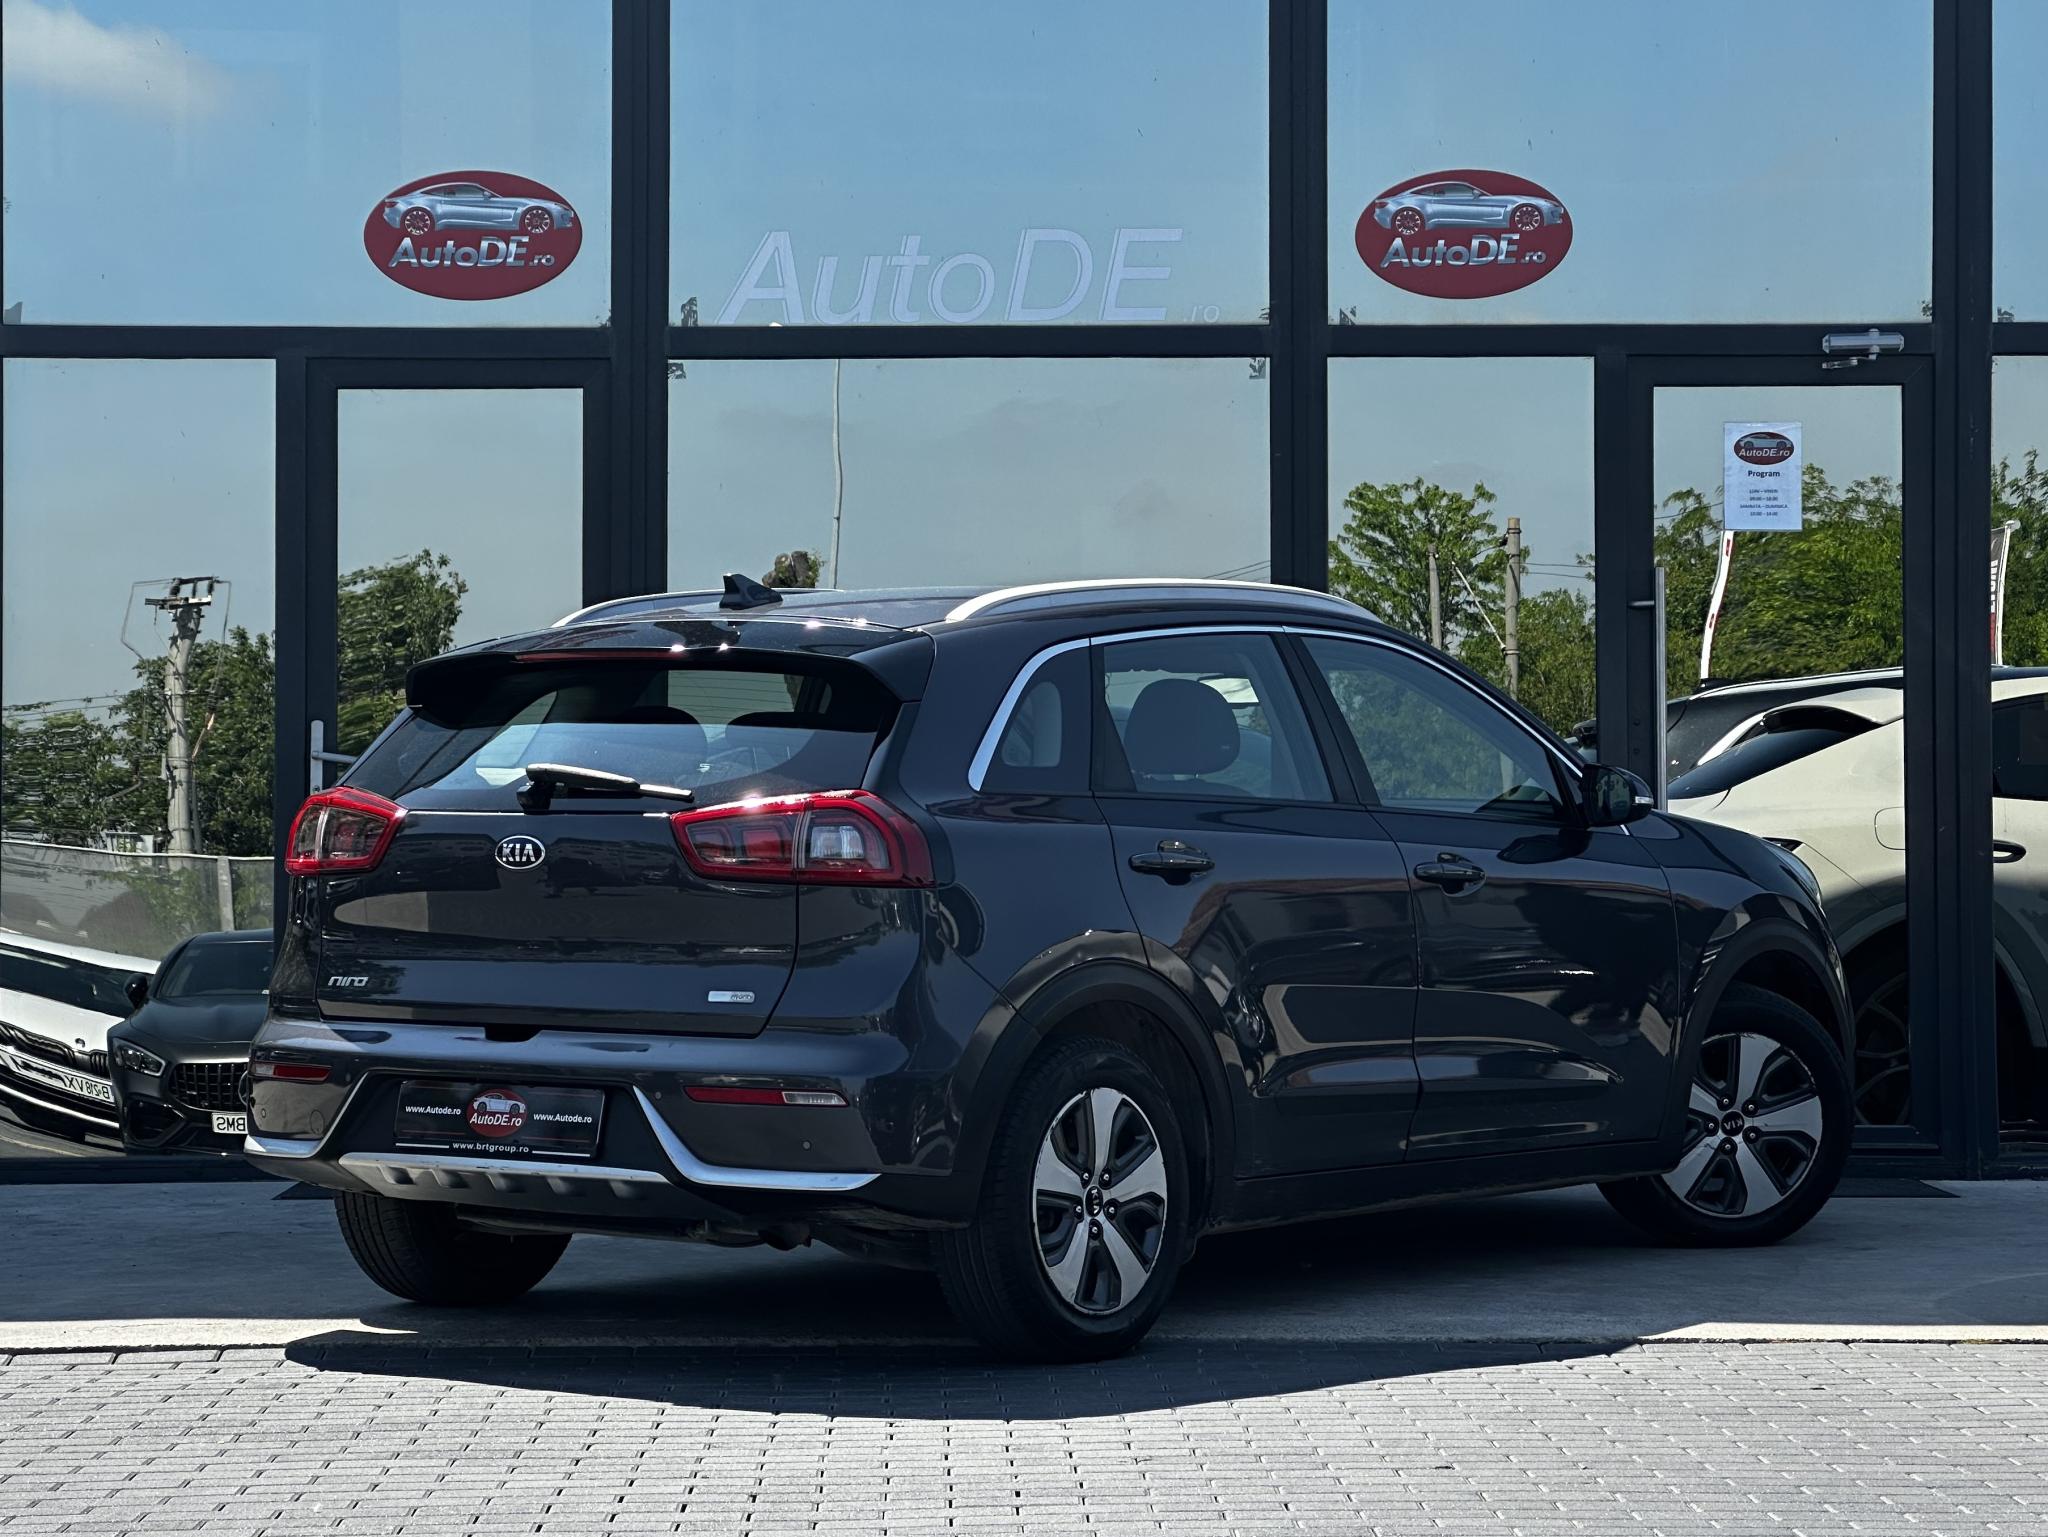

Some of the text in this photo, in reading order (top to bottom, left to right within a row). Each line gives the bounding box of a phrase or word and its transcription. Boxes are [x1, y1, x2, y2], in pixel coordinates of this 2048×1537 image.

[1739, 448, 1790, 457] AutoDE.ro
[1748, 470, 1780, 478] Program
[502, 843, 536, 862] KIA
[405, 1104, 462, 1115] www.Autode.ro
[469, 1112, 522, 1127] AutoDE.ro
[533, 1112, 593, 1123] www.Autode.ro
[452, 1141, 530, 1153] www.brtgroup.ro
